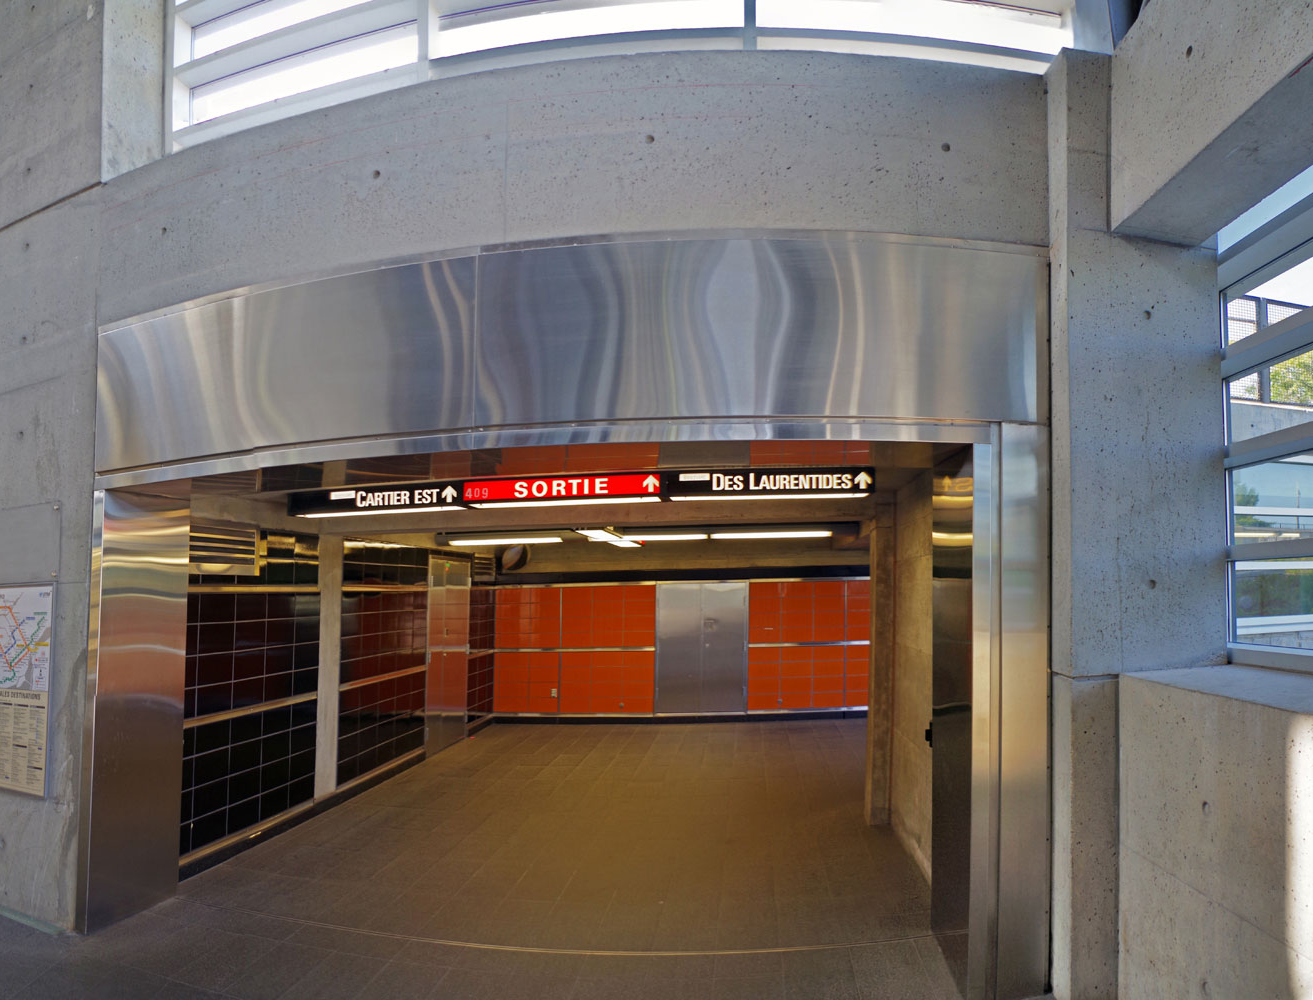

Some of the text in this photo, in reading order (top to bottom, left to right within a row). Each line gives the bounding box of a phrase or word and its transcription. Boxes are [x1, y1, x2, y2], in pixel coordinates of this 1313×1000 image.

[514, 478, 609, 499] SORTIE
[712, 473, 744, 491] DES
[748, 472, 853, 490] LAURENTIDES
[356, 490, 410, 508] CARTIER
[414, 488, 440, 504] EST
[465, 487, 489, 499] 409
